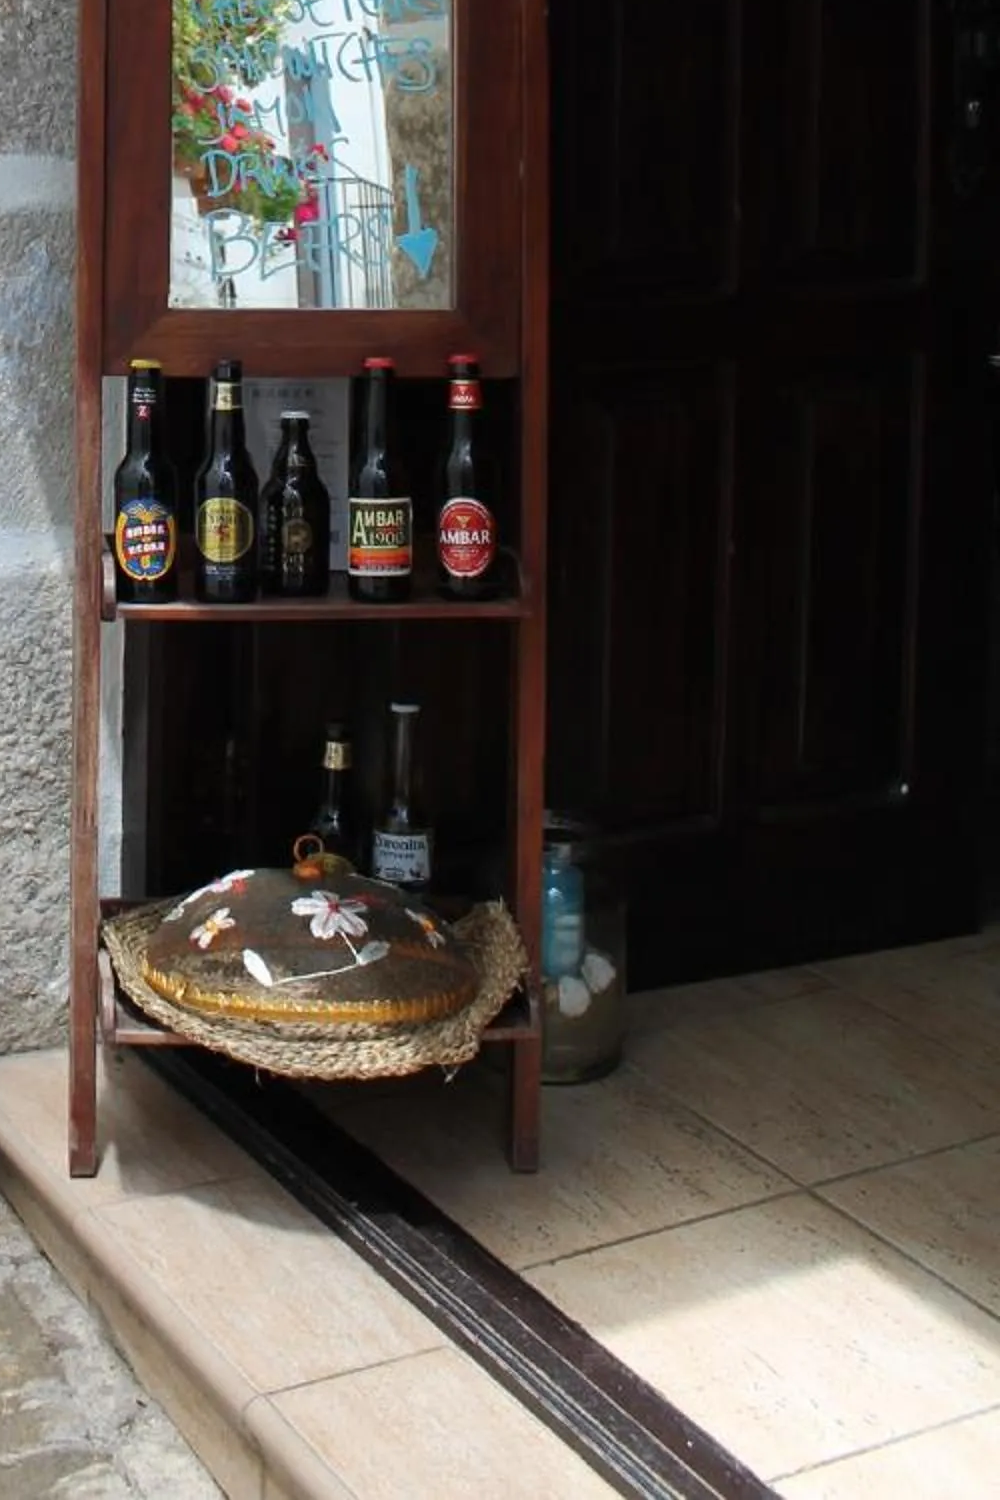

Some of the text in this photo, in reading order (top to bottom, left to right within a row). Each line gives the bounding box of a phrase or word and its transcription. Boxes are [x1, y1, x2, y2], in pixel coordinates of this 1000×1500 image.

[204, 207, 391, 282] BEERS
[352, 508, 405, 545] AMBAR
[439, 528, 491, 543] AMBAR
